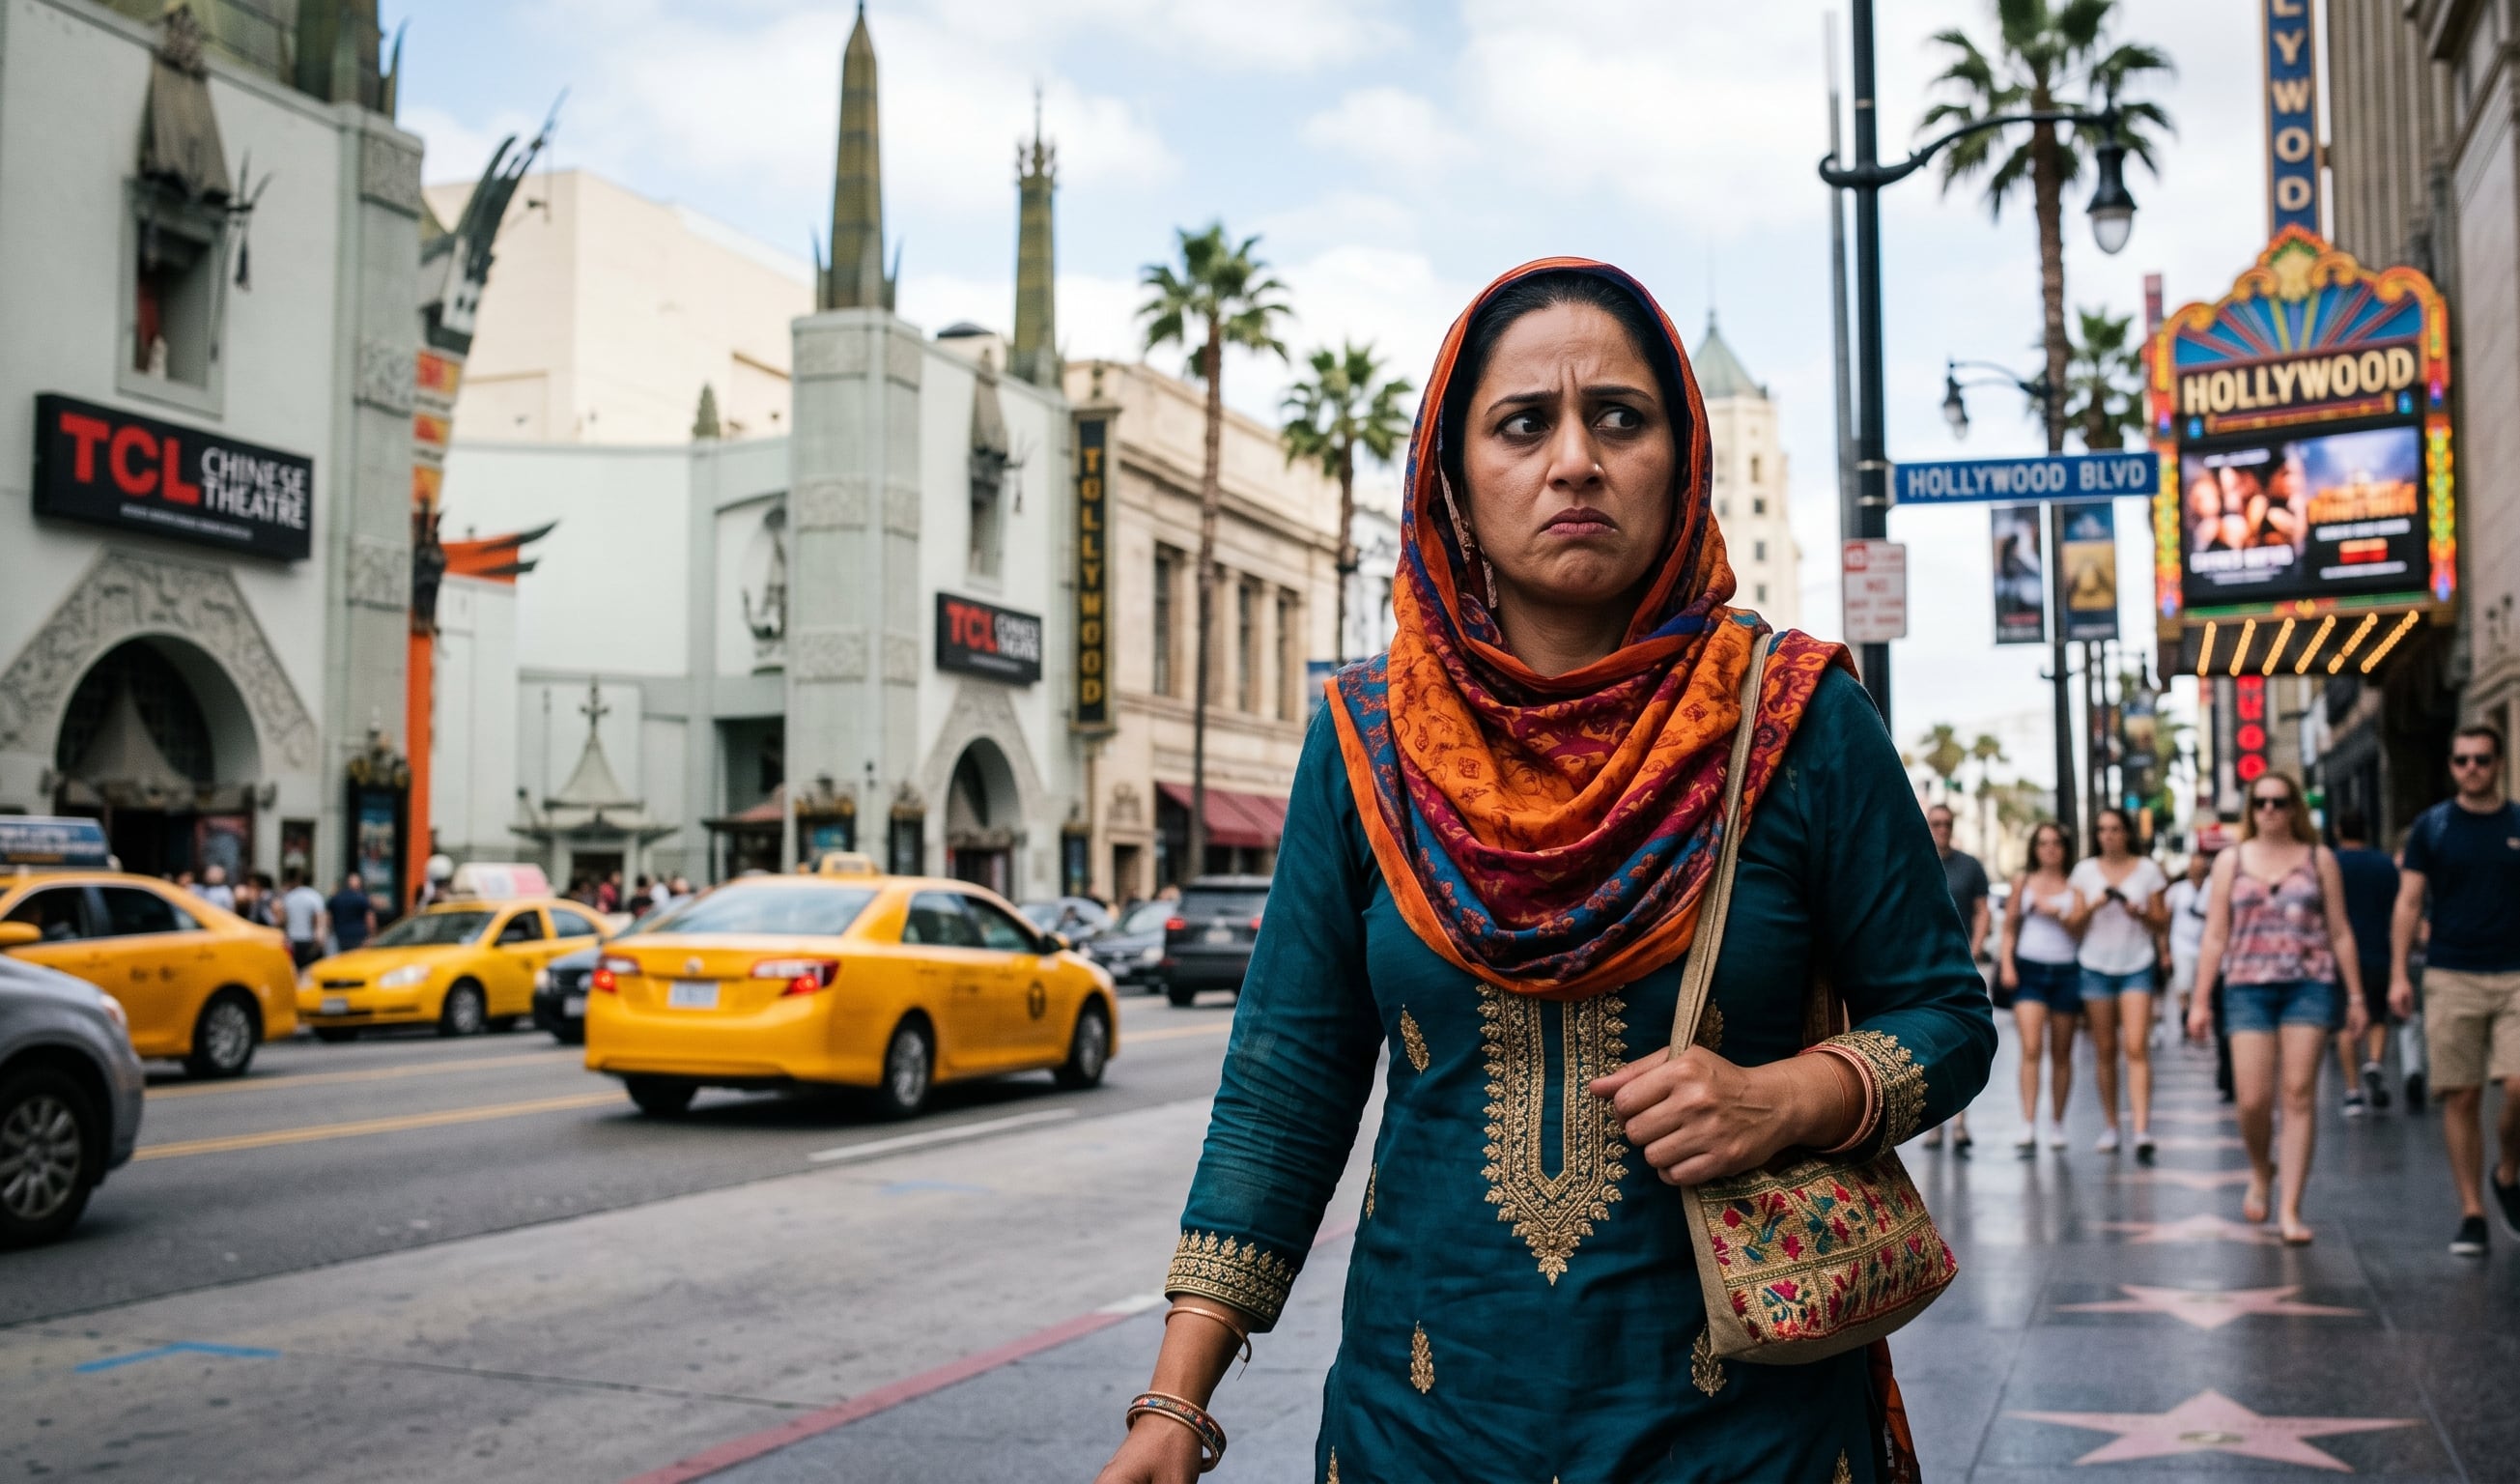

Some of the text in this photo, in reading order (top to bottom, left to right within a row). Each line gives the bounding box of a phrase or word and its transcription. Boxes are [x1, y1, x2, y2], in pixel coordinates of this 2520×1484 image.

[2183, 348, 2415, 414] HOLLYWOOD
[60, 413, 200, 504] TCL
[201, 446, 306, 489] CHINESE
[1908, 459, 2147, 498] HOLLYWOOD BLVD
[202, 478, 306, 529] THEATRE
[1081, 447, 1102, 703] TOLLYWOOD
